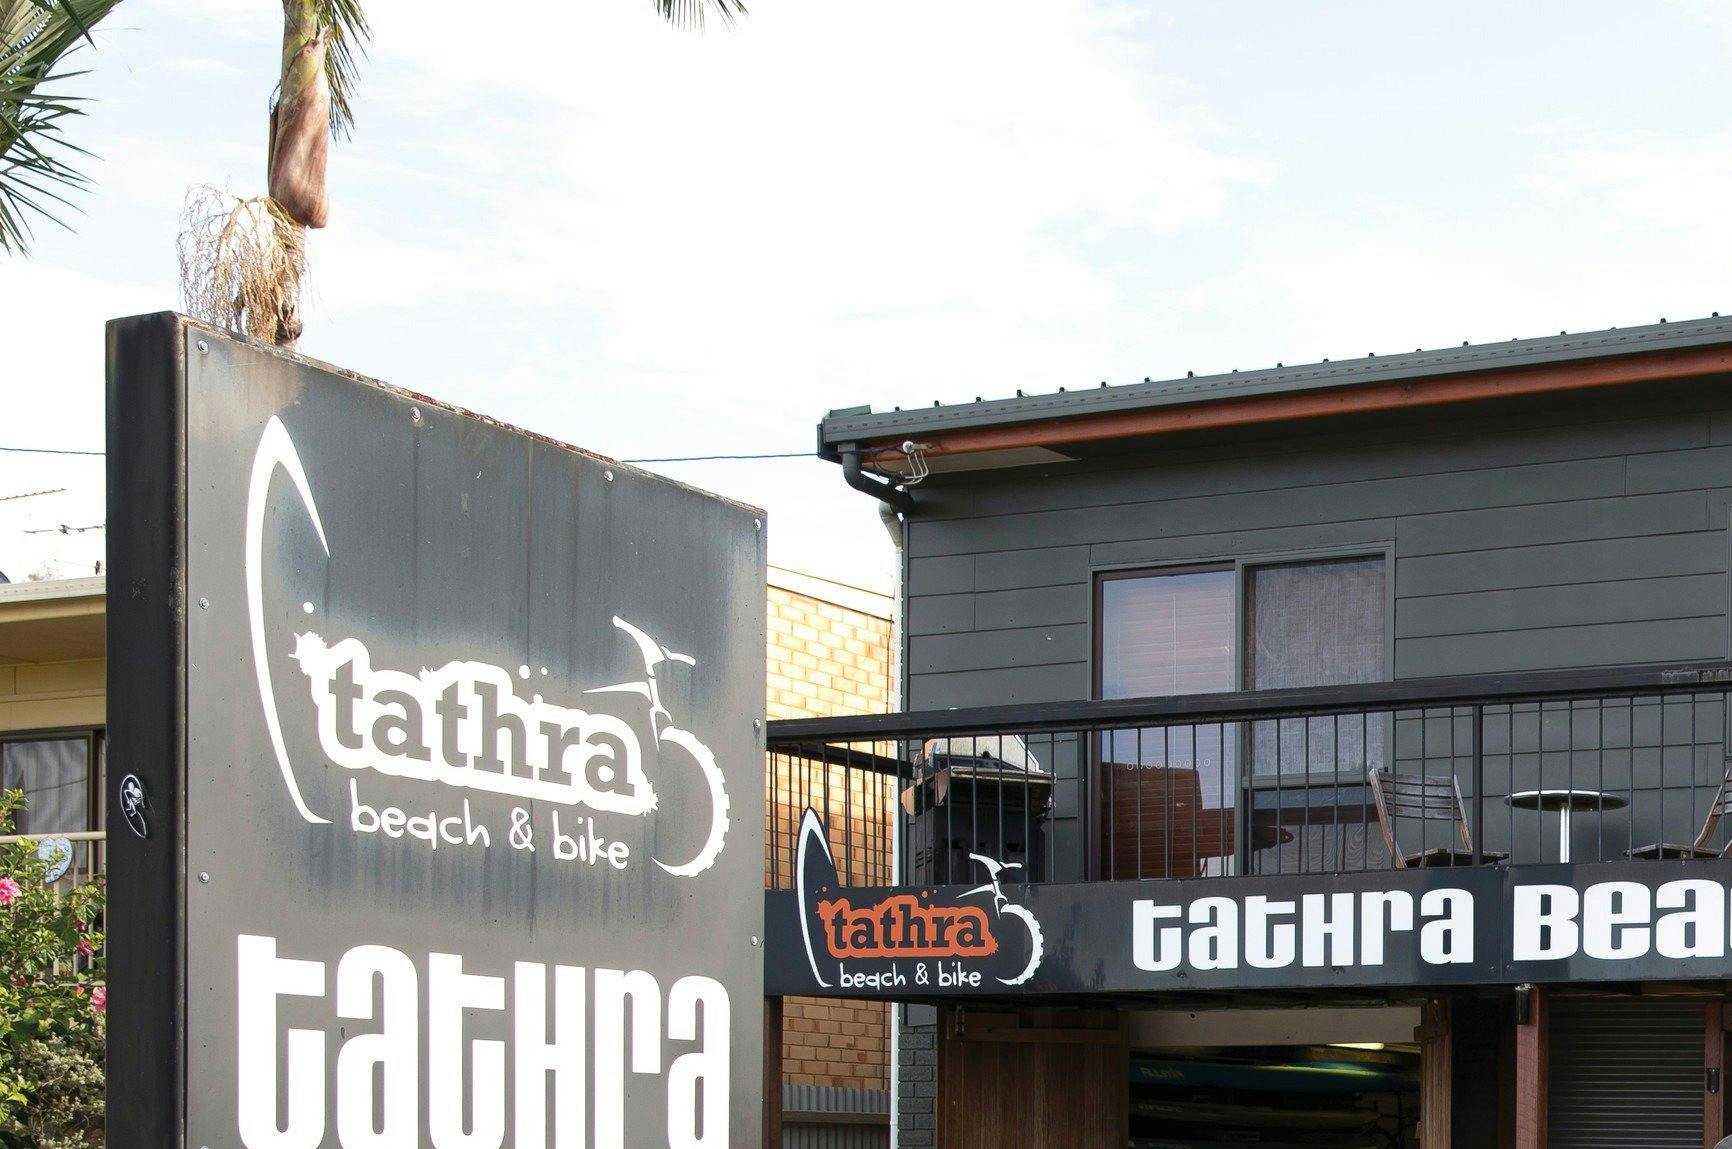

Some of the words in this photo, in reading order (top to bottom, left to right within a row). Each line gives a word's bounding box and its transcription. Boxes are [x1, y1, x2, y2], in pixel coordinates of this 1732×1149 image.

[328, 658, 636, 797] tathra
[350, 777, 490, 851] beach
[508, 806, 536, 853] &
[552, 809, 631, 870] bike
[832, 904, 985, 949] tathra
[840, 962, 906, 990] beach
[915, 962, 930, 985] &
[938, 961, 982, 987] bike
